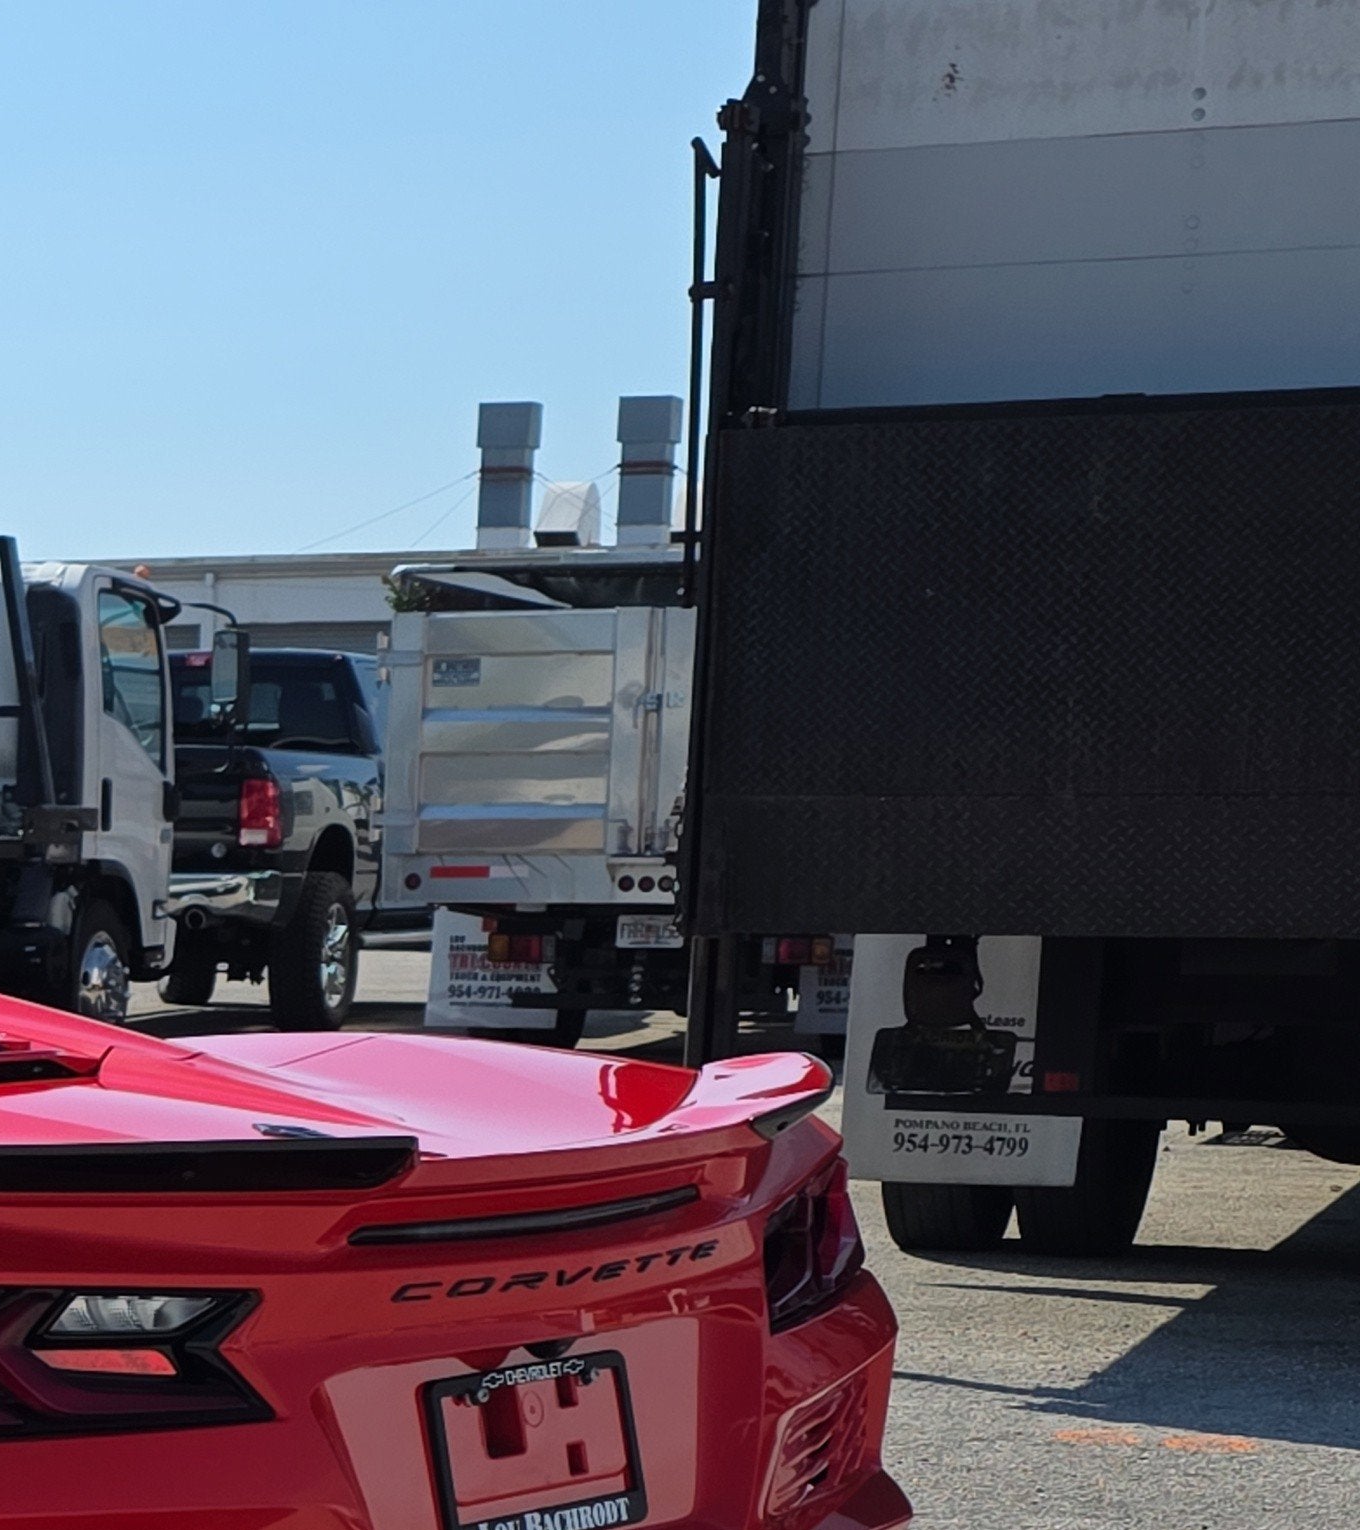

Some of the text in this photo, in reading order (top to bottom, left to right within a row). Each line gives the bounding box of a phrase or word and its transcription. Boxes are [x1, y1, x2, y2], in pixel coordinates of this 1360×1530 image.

[894, 1118, 960, 1131] POMPANO
[893, 1132, 1029, 1157] 954-973-4799
[391, 1239, 718, 1302] CORVETTE
[505, 1361, 562, 1386] CHEVROLET
